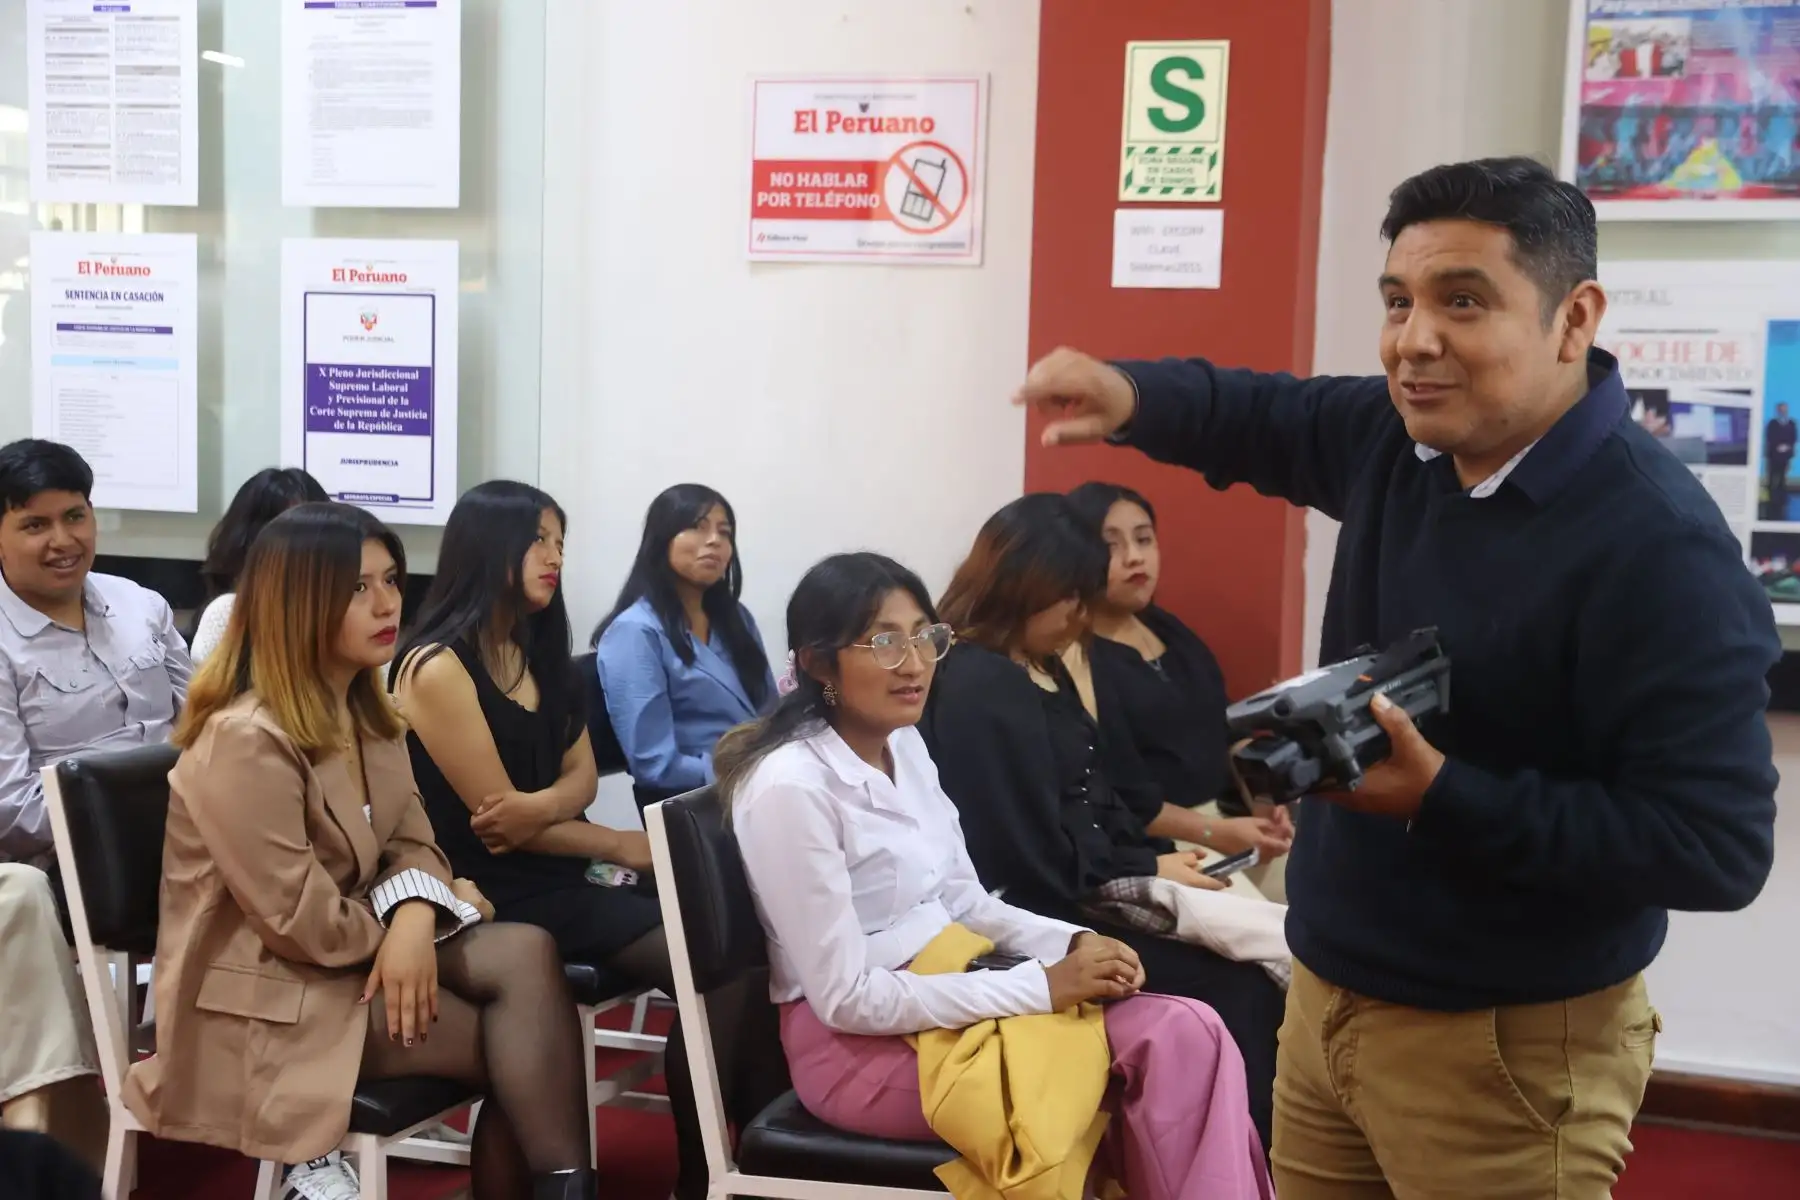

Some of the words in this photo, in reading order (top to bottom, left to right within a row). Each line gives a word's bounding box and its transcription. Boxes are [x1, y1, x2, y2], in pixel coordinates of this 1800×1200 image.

[1147, 56, 1205, 133] S
[794, 110, 817, 134] El
[825, 110, 935, 134] Peruano
[770, 172, 794, 188] NO
[797, 172, 868, 188] HABLAR
[757, 191, 791, 207] POR
[795, 189, 881, 208] TELÉFONO
[78, 261, 91, 275] El
[94, 261, 151, 277] Peruano
[332, 268, 346, 282] El
[349, 268, 408, 283] Peruano
[65, 289, 109, 301] SENTENCIA
[111, 291, 122, 301] EN
[123, 290, 165, 302] CASACIÓN
[1611, 340, 1694, 363] OCHE
[319, 367, 327, 378] X
[329, 367, 354, 378] Pleno
[356, 368, 419, 380] Jurisdiccional
[329, 381, 370, 393] Supremo
[372, 382, 409, 393] Laboral
[328, 396, 334, 405] y
[336, 394, 386, 406] Previsional
[388, 396, 399, 406] de
[400, 396, 409, 406] la
[309, 406, 336, 417] Corte
[337, 407, 378, 419] Suprema
[380, 407, 391, 418] de
[393, 409, 428, 420] Justicia
[334, 420, 345, 430] de
[347, 420, 355, 430] la
[358, 421, 403, 433] República
